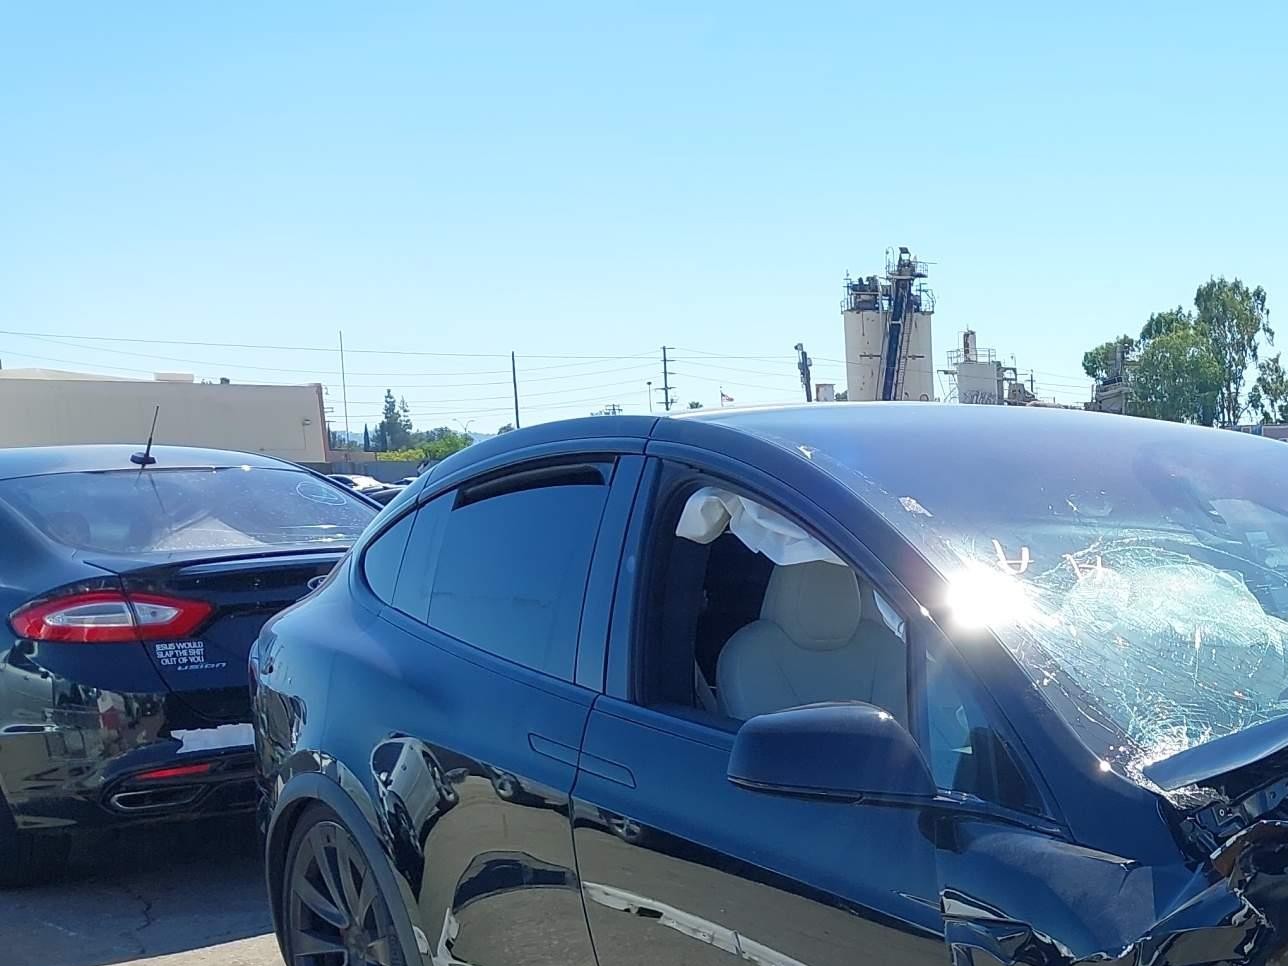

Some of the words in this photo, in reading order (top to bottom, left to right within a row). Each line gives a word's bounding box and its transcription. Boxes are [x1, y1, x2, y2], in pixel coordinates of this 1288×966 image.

[176, 641, 204, 650] WOULD
[174, 649, 188, 657] THE
[160, 657, 177, 665] OUT
[188, 655, 205, 663] YOU
